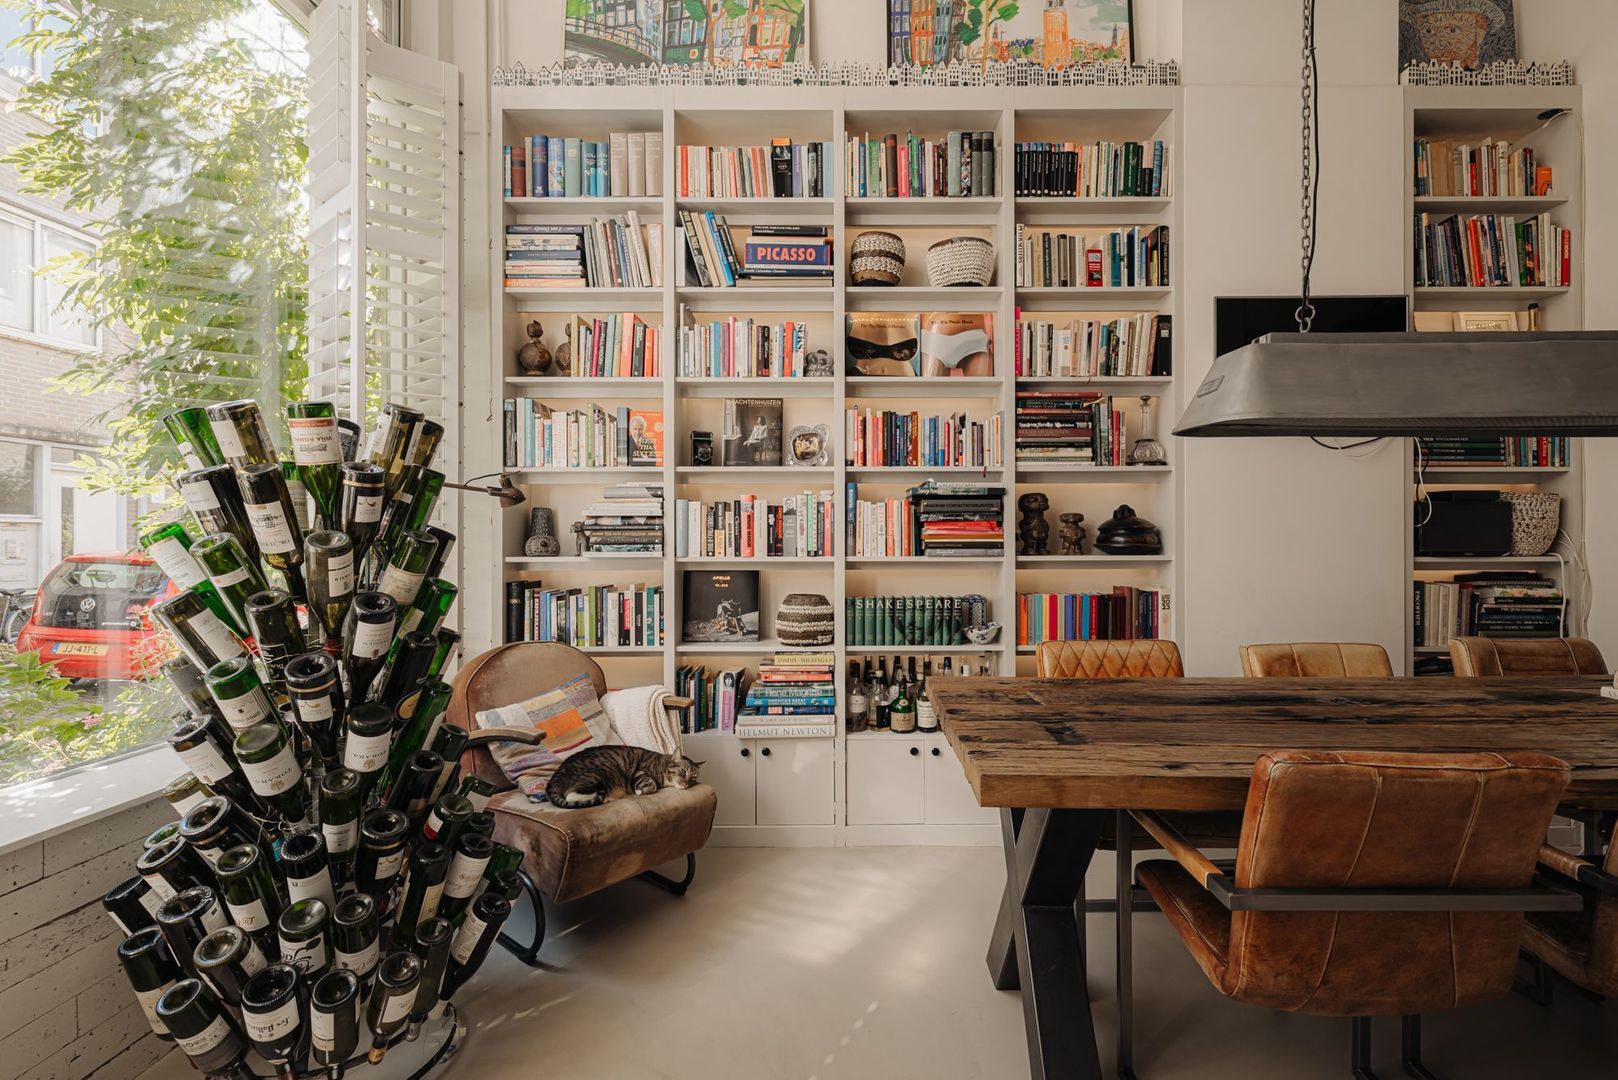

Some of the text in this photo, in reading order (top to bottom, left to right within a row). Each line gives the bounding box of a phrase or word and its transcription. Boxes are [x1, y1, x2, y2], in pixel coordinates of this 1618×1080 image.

[756, 247, 816, 262] PICASSO
[856, 599, 962, 609] SHAKESPEARE
[768, 706, 783, 714] LIFE
[739, 727, 827, 737] HELMUT NEWTON
